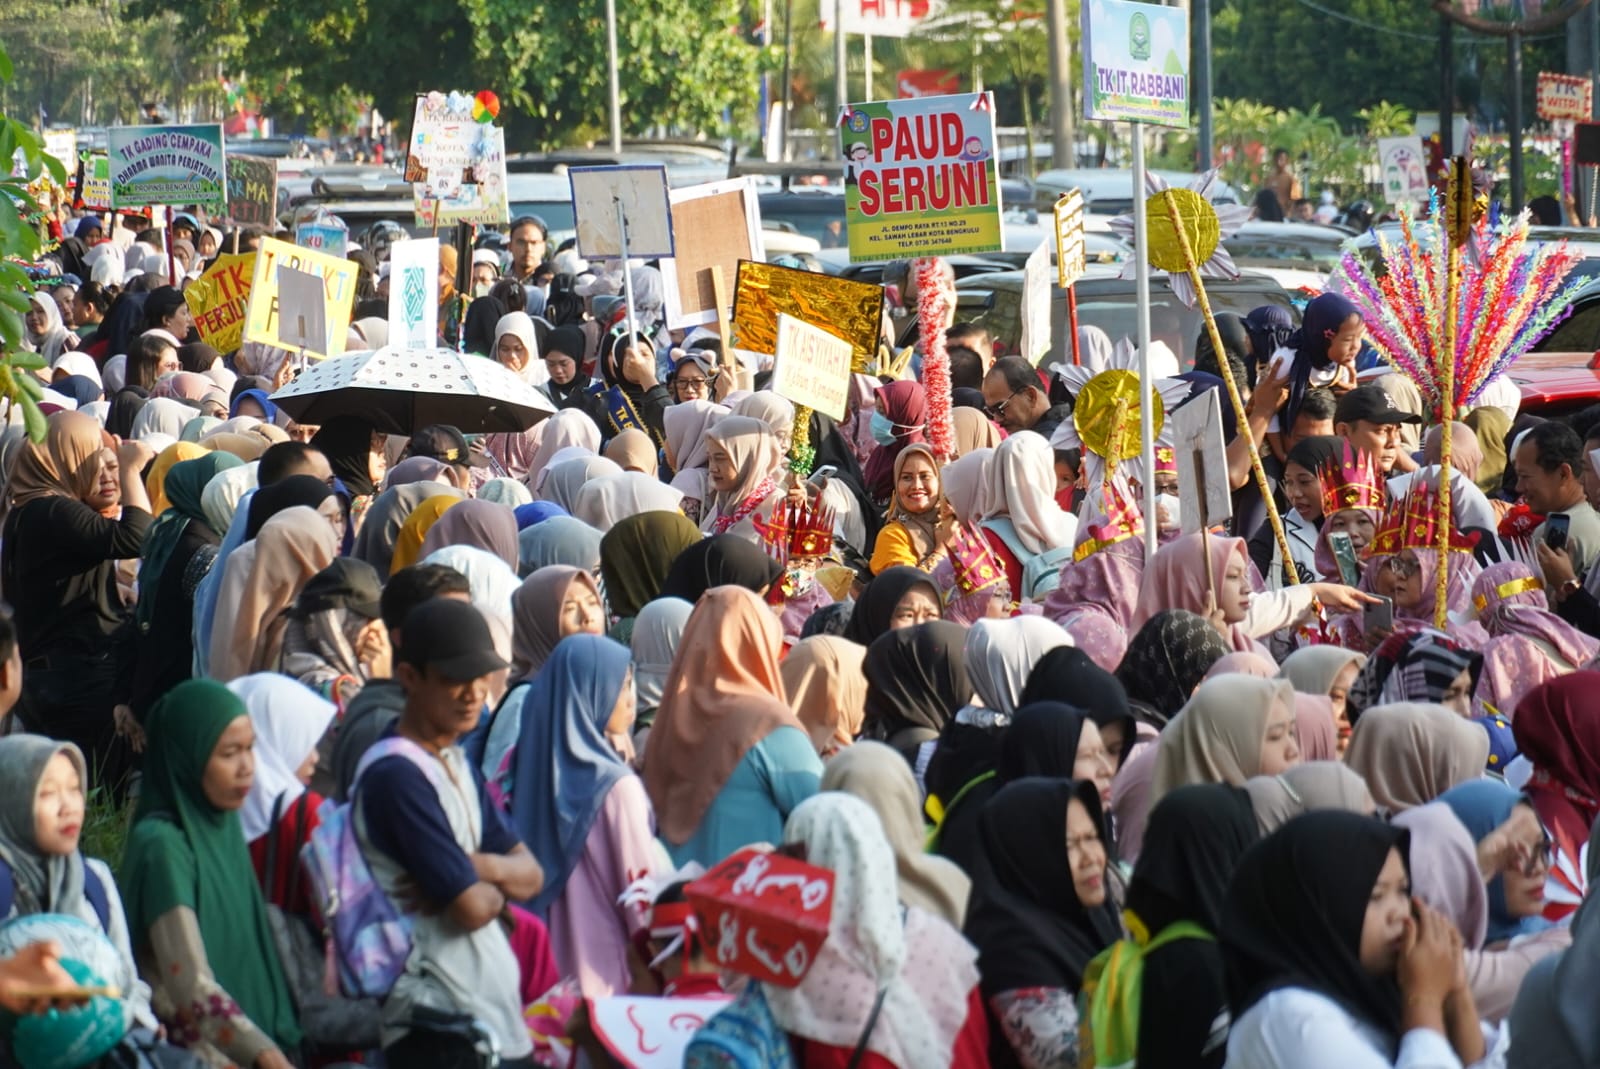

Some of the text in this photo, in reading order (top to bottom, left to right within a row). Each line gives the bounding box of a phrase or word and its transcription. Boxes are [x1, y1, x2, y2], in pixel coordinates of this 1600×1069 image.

[1098, 67, 1184, 100] TK IT RABBANI
[120, 134, 213, 161] TK GADING CEMPAKA
[872, 112, 964, 163] PAUD
[117, 154, 217, 185] DHARMA WANITA PERSATUAN
[165, 182, 201, 192] BENGKULU
[859, 161, 988, 216] SERUNI
[946, 227, 980, 236] BENGKULU
[212, 261, 251, 300] TK
